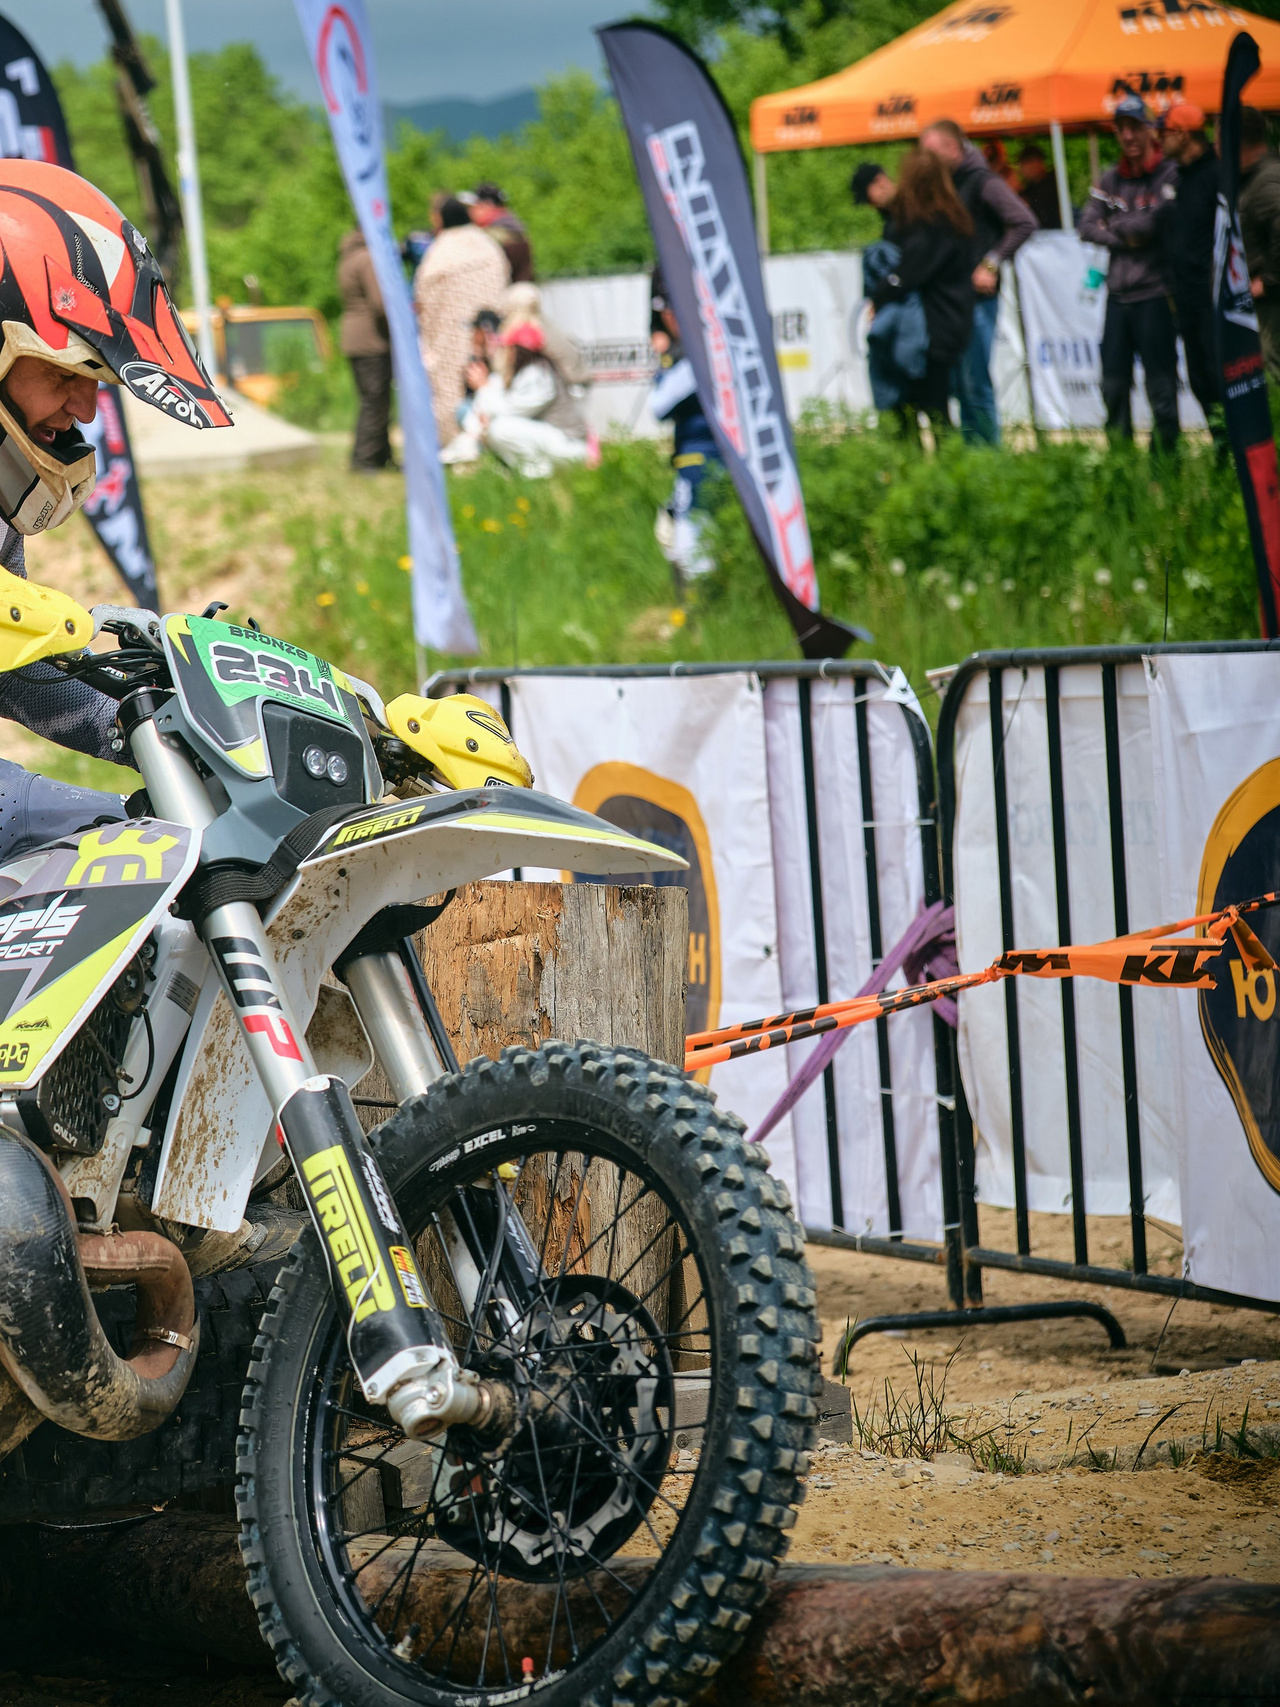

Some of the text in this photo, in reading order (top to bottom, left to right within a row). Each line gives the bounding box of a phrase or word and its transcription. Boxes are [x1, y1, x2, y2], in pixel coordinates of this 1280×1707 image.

[228, 625, 308, 661] BRONZE
[208, 640, 345, 718] 234
[332, 805, 426, 847] PIRELLI
[463, 1128, 507, 1154] EXCEL
[301, 1144, 397, 1325] PIRELLI
